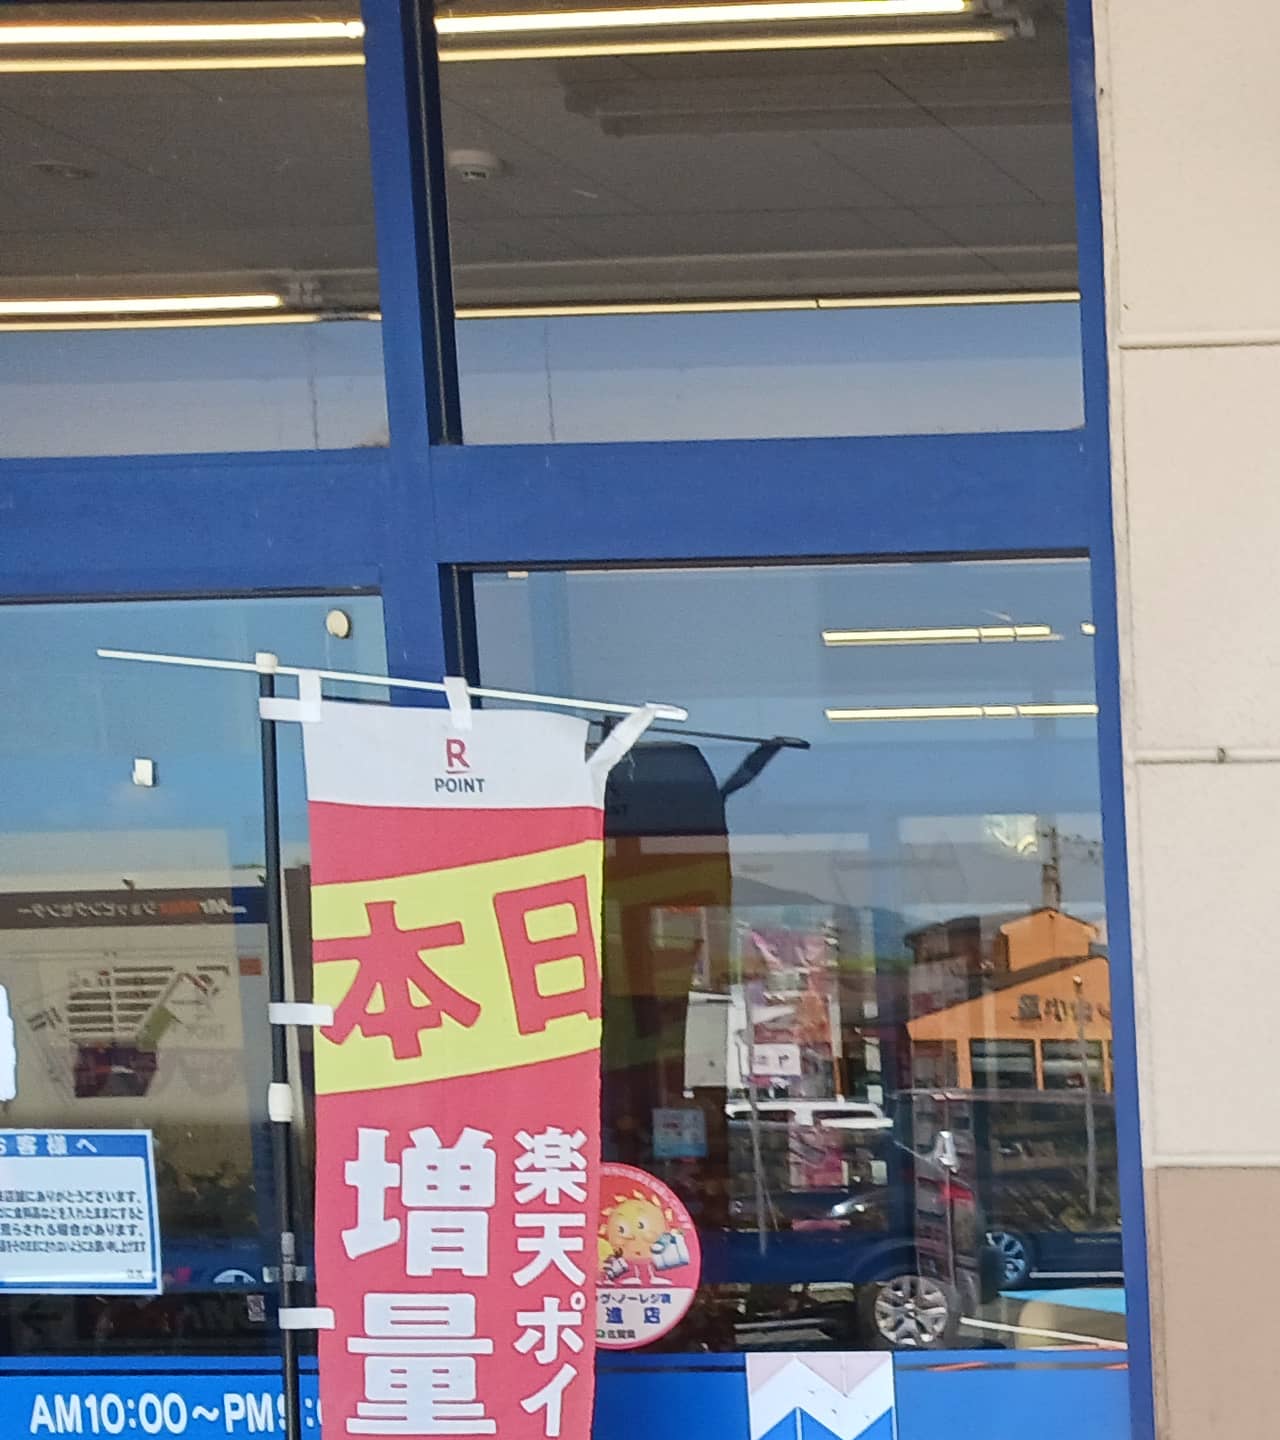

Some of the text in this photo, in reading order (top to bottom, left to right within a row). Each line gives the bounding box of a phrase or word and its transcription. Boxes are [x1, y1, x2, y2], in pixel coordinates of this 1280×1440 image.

[446, 738, 470, 768] R
[434, 777, 486, 794] POINT
[313, 873, 602, 1060] 本日
